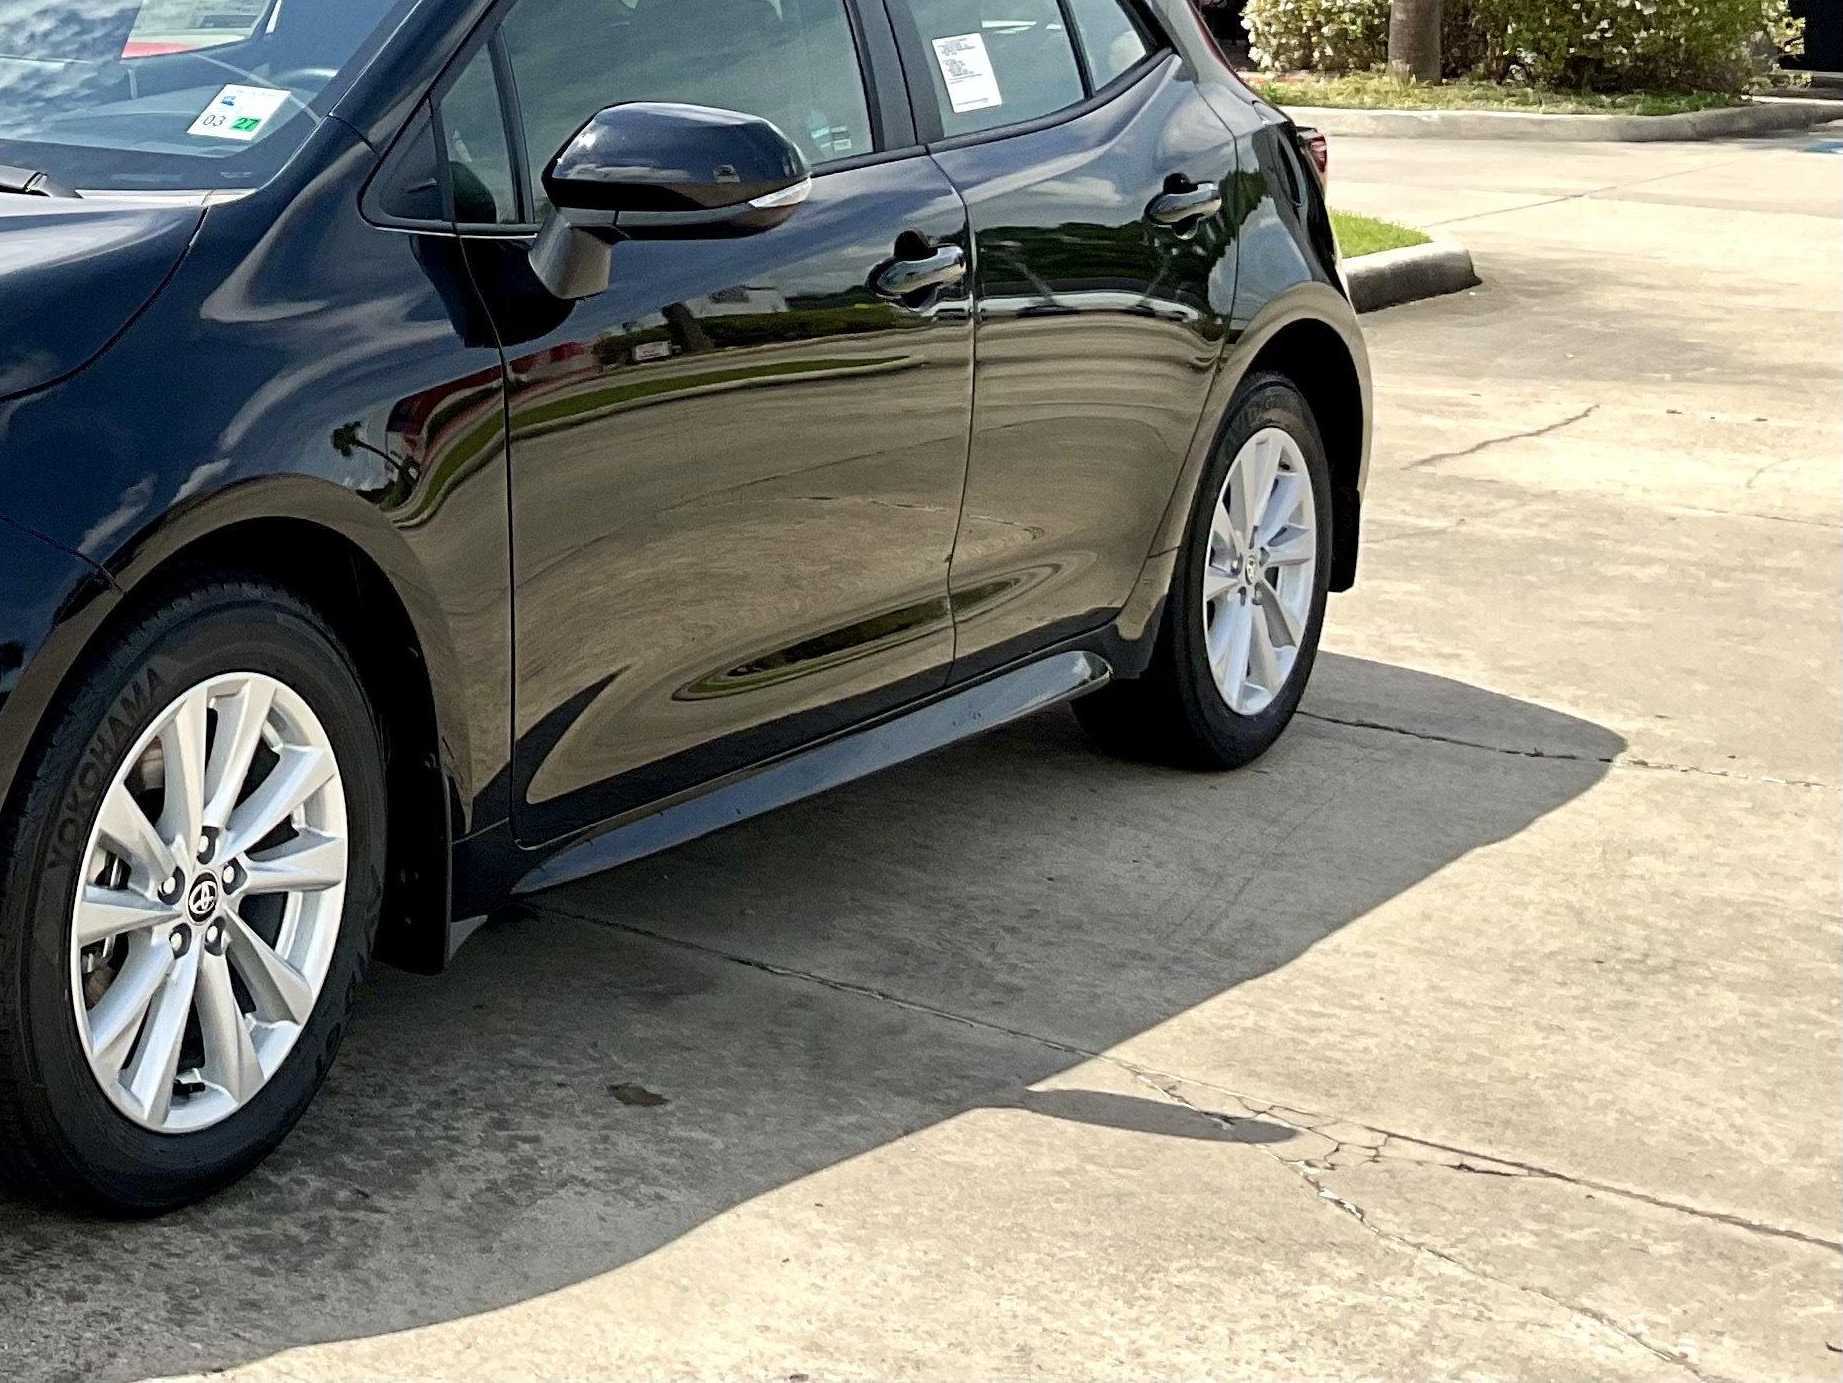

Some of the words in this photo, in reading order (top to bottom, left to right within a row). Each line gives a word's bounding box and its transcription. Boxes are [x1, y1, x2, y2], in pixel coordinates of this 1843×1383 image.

[202, 114, 227, 127] 03
[231, 117, 259, 130] 27
[46, 667, 165, 870] YOKOHAMA
